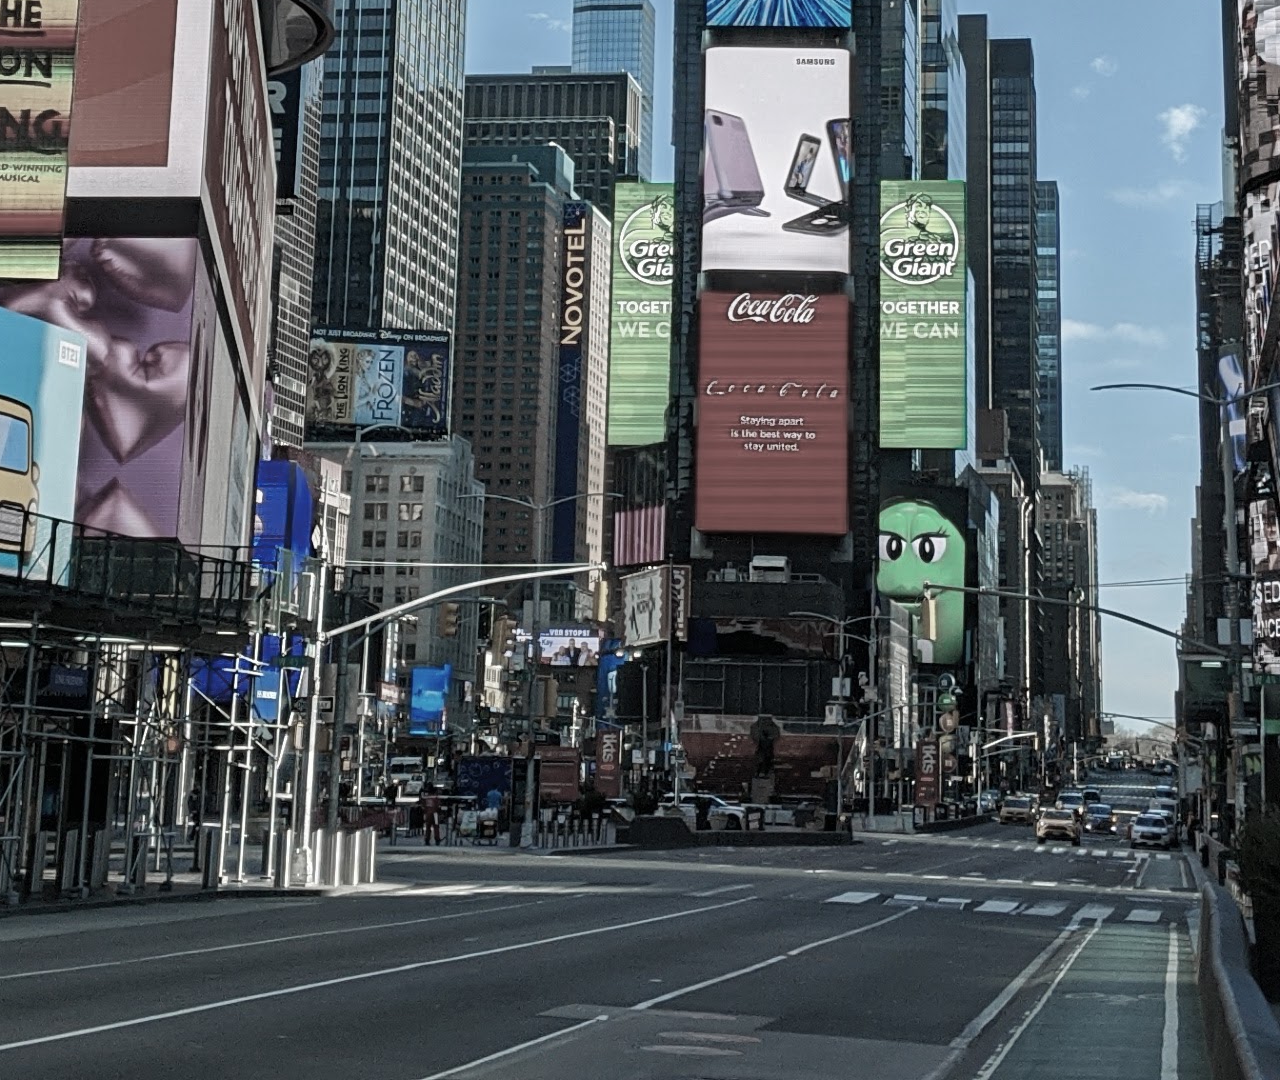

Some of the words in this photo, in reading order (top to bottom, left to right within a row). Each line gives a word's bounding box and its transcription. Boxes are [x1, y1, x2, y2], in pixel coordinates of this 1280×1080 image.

[795, 57, 835, 66] SAMSUNG
[629, 240, 674, 258] Gre
[884, 238, 955, 257] Green
[635, 256, 674, 277] Gia
[891, 256, 956, 277] Giant
[561, 218, 586, 345] NOVOTEL
[617, 301, 672, 314] TOGET
[727, 292, 819, 324] Coca-Cola
[313, 328, 327, 336] NOT
[327, 329, 341, 337] JUST
[379, 329, 401, 343] Disney
[414, 335, 448, 343] BROADWAY
[618, 322, 650, 338] WE
[913, 322, 959, 339] CAN
[335, 348, 350, 373] KING
[333, 376, 349, 400] LION
[372, 349, 397, 421] FROZEN
[336, 400, 347, 420] THE
[740, 415, 776, 428] Staying
[778, 416, 804, 428] apart
[731, 428, 740, 439] is
[741, 428, 758, 439] the
[759, 428, 782, 439] best
[783, 431, 803, 443] way
[805, 430, 816, 440] to
[744, 443, 764, 453] stay
[767, 441, 800, 452] united.
[564, 629, 591, 637] STOPS!
[602, 733, 618, 763] tkts
[922, 744, 937, 774] tkts
